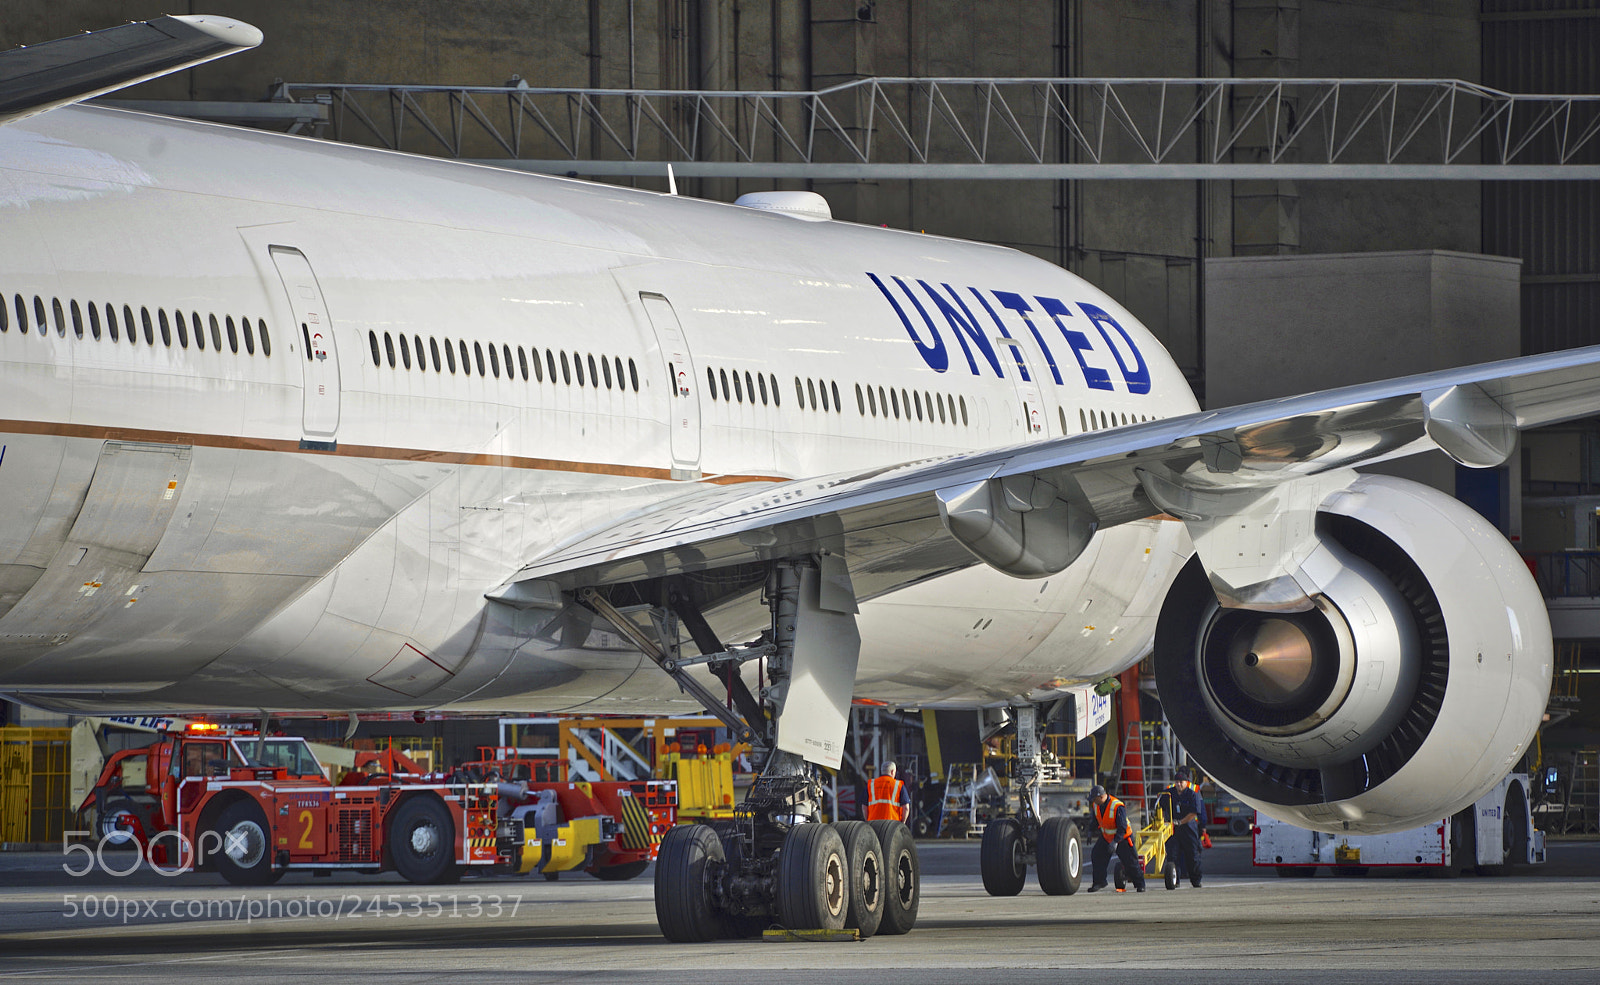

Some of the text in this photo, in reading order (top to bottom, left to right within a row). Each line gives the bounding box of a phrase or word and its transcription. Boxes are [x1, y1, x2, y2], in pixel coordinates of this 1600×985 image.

[865, 271, 1152, 396] UNITED
[289, 793, 320, 801] UNITED
[1481, 808, 1497, 817] UNITED
[298, 810, 313, 849] 2
